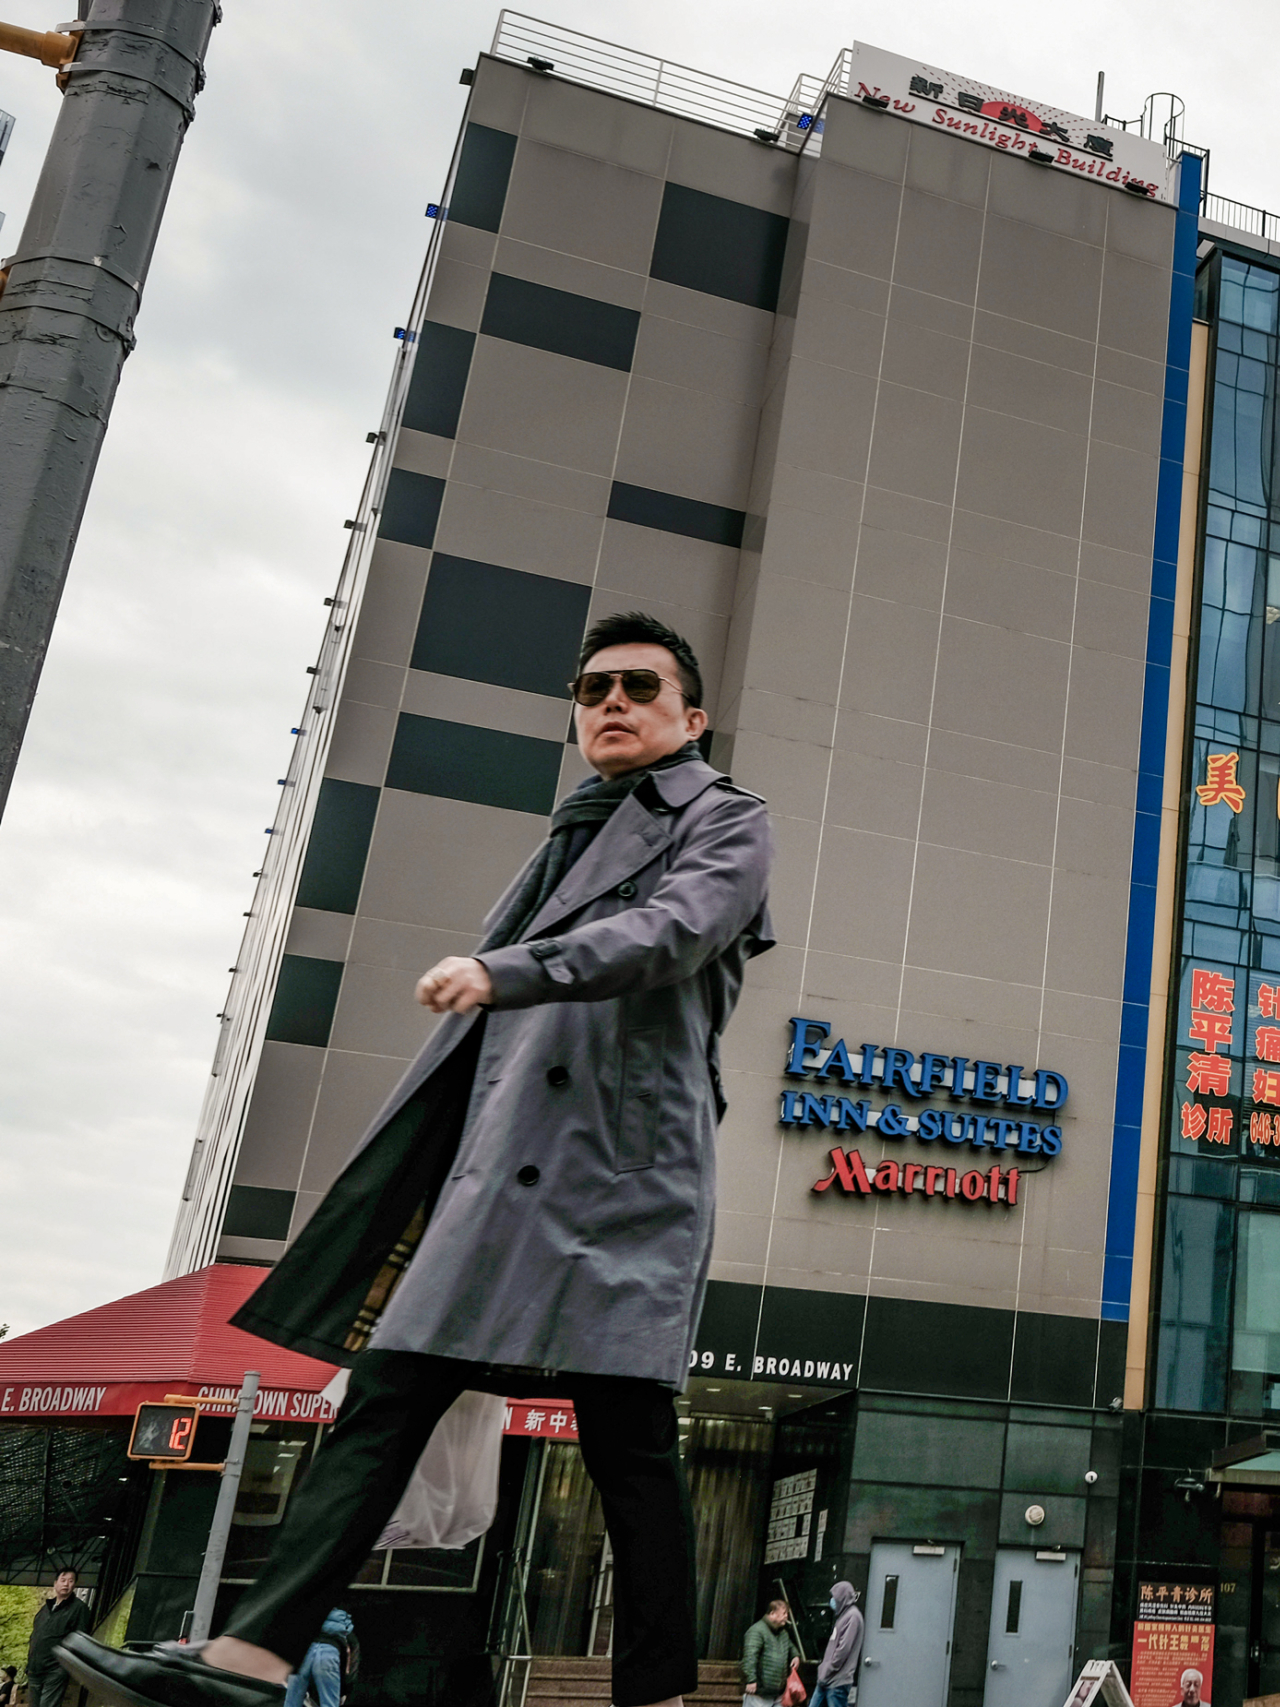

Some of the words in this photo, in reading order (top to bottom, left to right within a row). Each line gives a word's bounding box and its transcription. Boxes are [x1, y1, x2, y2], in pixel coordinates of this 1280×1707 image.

[854, 82, 916, 113] New
[932, 108, 1039, 149] Sunlight
[1053, 148, 1159, 197] Building
[784, 1017, 1069, 1110] FAIRFIELD
[779, 1090, 872, 1132] INN
[877, 1104, 911, 1137] &
[917, 1109, 1063, 1156] SUITES
[1181, 1101, 1234, 1145] 诊所
[811, 1146, 1020, 1206] Marriott
[724, 1353, 742, 1372] E.
[754, 1355, 854, 1381] BROADWAY
[18, 1386, 107, 1412] BROADWAY
[168, 1417, 192, 1450] 12
[1220, 1582, 1237, 1594] 107
